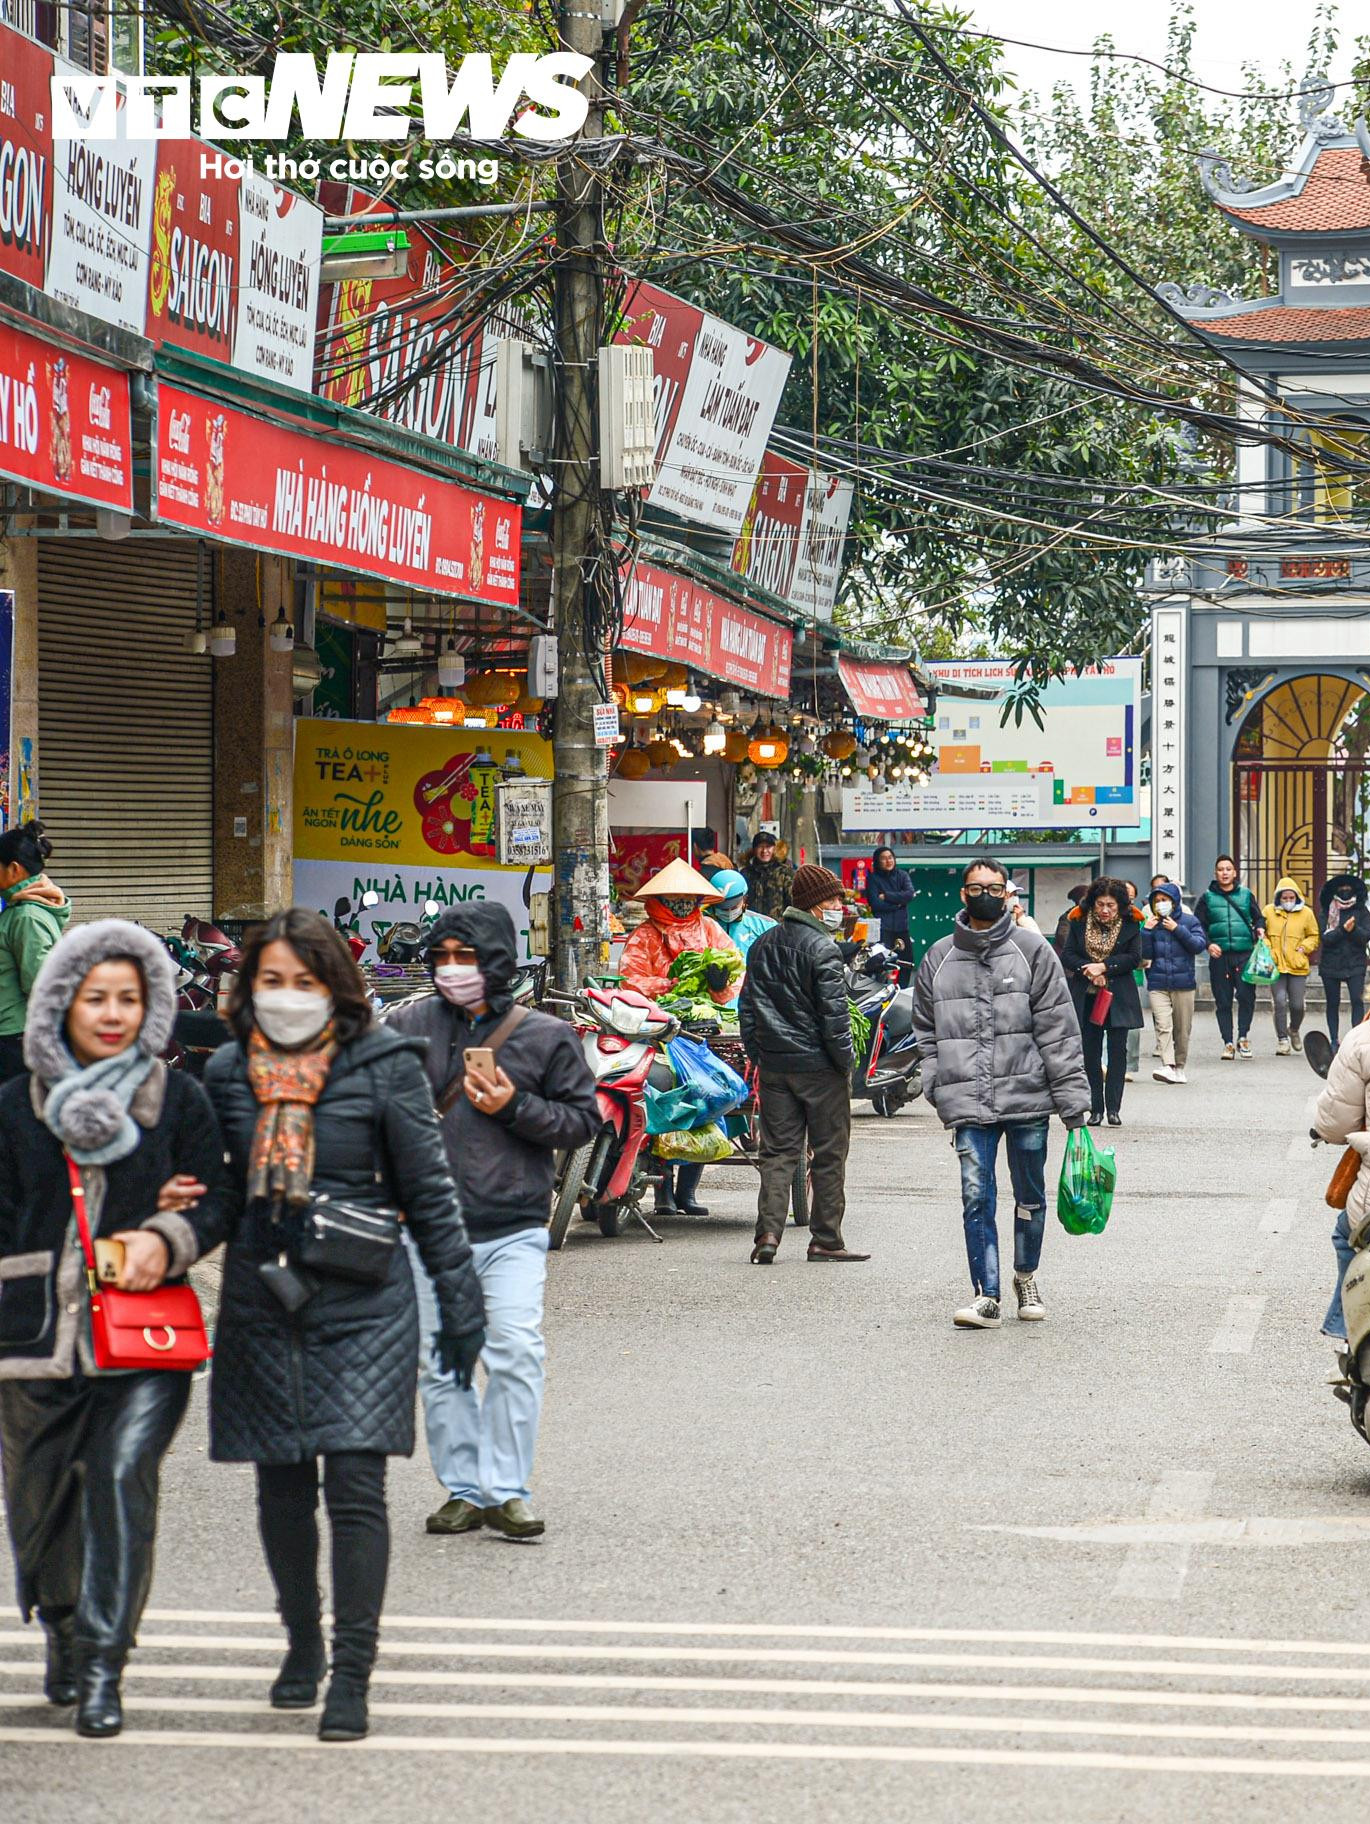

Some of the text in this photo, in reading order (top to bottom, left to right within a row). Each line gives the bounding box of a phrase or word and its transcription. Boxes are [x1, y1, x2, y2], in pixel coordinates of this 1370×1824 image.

[0, 140, 45, 246] GON
[168, 226, 233, 335] SAIGON
[700, 371, 725, 425] LÂM
[718, 380, 743, 434] TUẤN
[272, 458, 302, 537] NHÀ
[305, 465, 347, 547] HÀNG
[347, 472, 389, 559] HỒNG
[389, 494, 432, 571] LUYẾN
[316, 746, 389, 762] TRÀ Ô LONG
[303, 807, 340, 818] ĂN TẾT
[304, 819, 337, 828] NGON
[334, 790, 403, 839] nhẹ
[353, 873, 485, 906] NHÀ HÀNG
